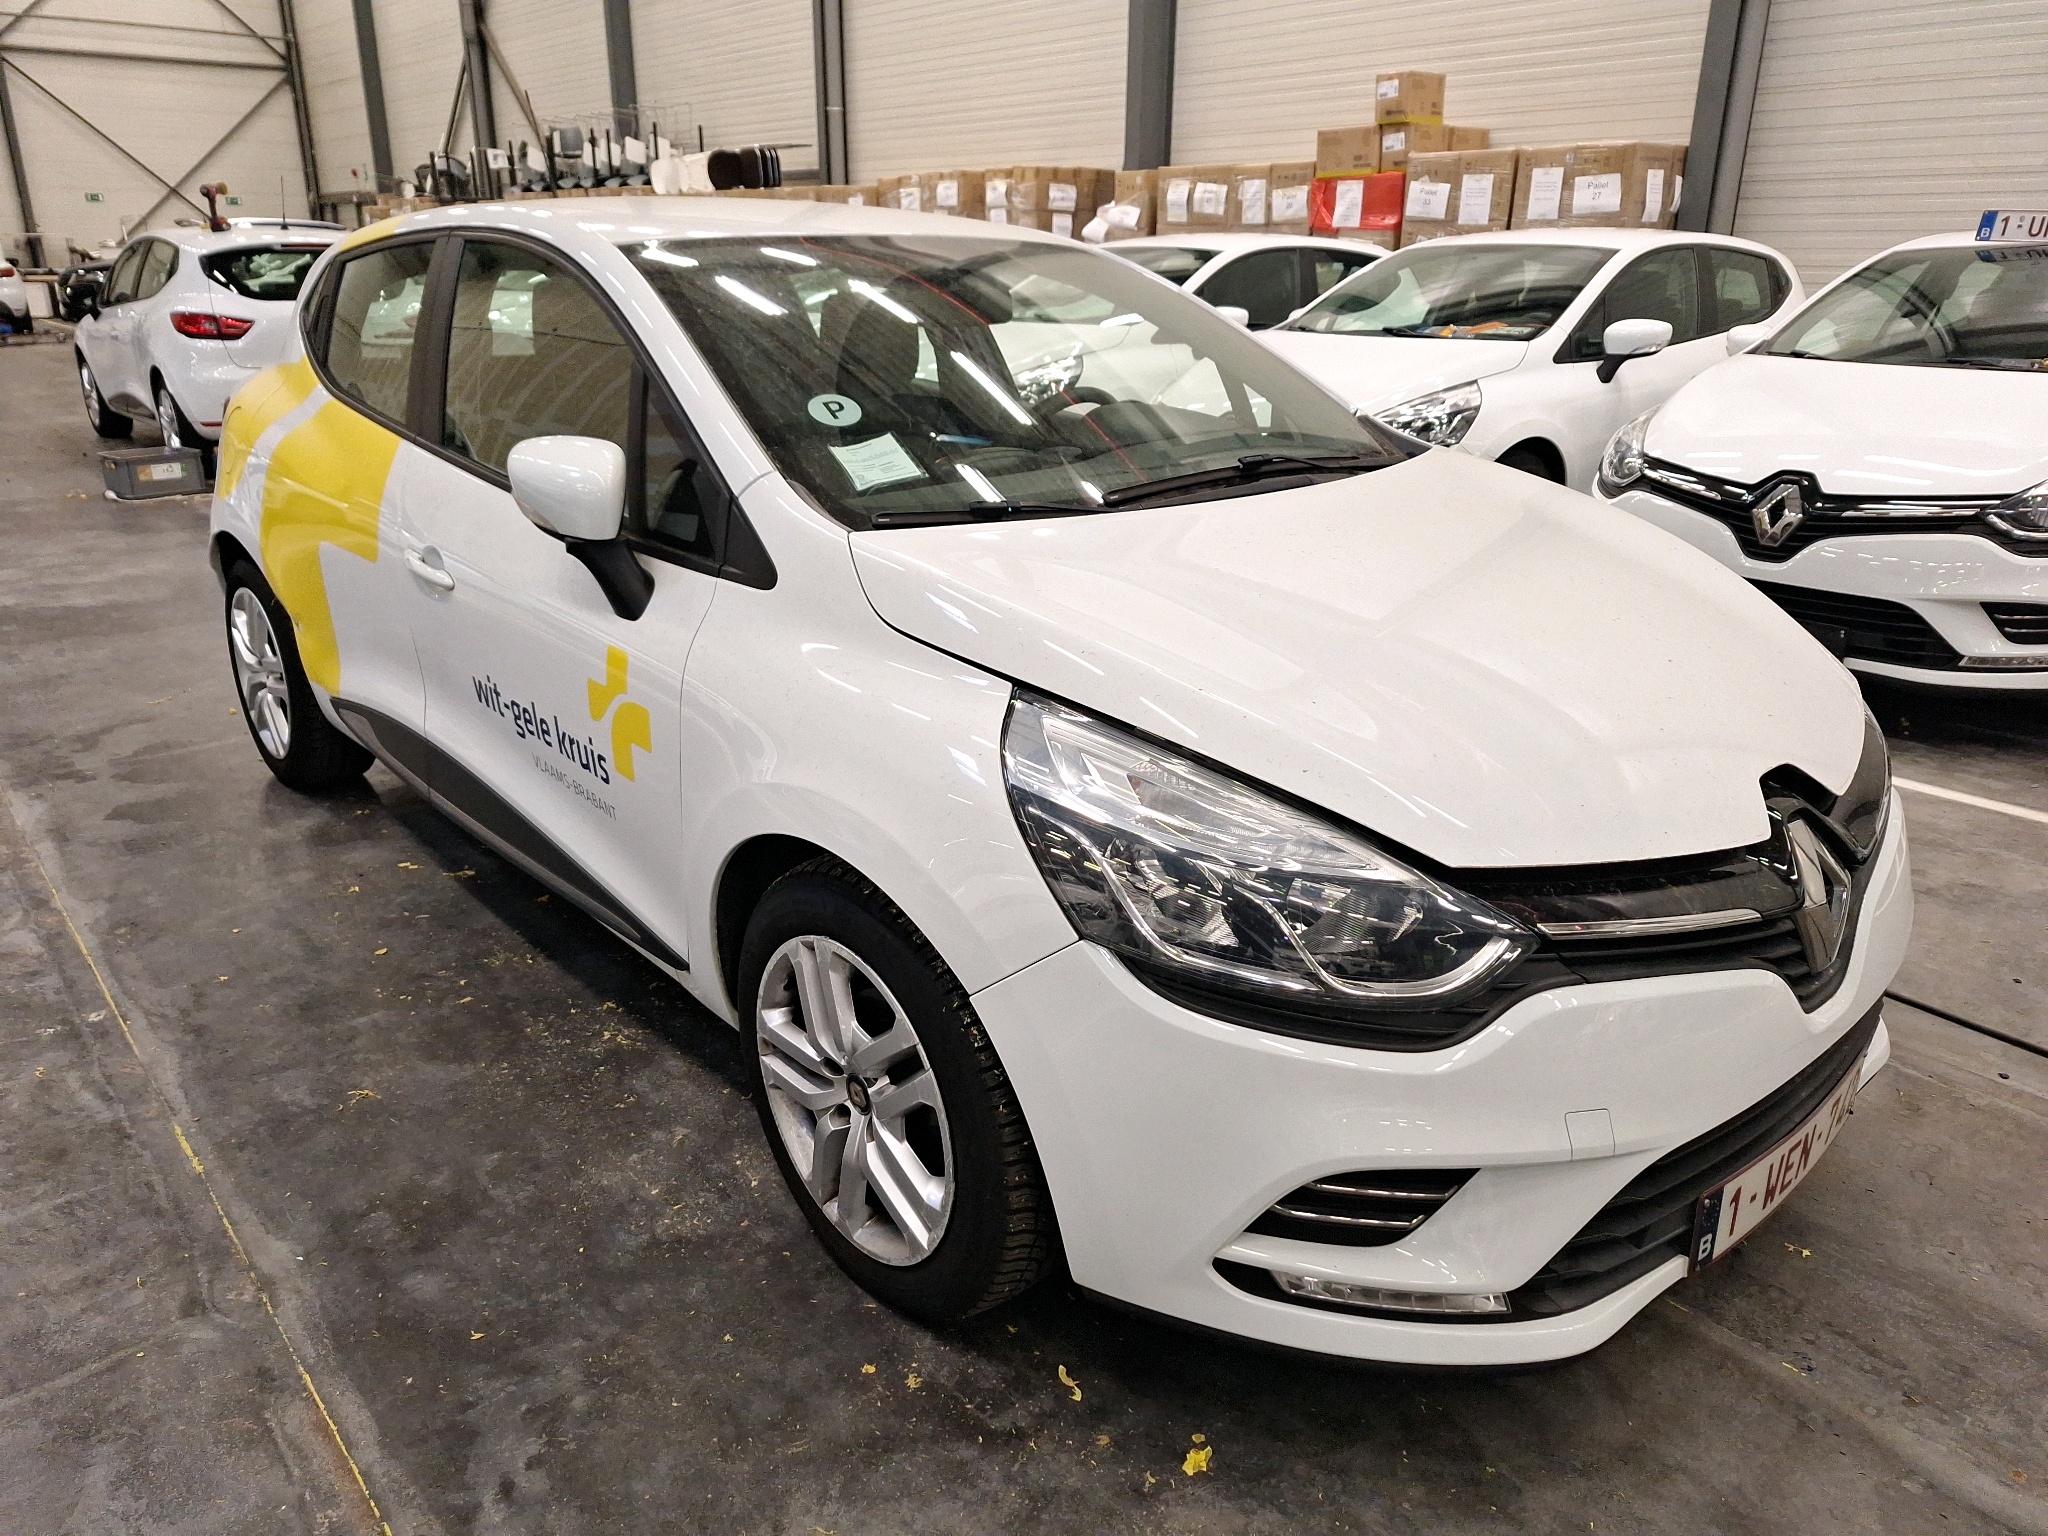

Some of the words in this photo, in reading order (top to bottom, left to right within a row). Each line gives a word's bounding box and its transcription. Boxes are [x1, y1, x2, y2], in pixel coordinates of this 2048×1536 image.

[1981, 227, 1991, 238] B
[822, 401, 845, 420] P
[472, 674, 553, 748] wit-gele
[553, 715, 611, 785] kruis
[531, 752, 617, 822] VLAAMS-BRABANT
[1698, 1233, 1713, 1261] B
